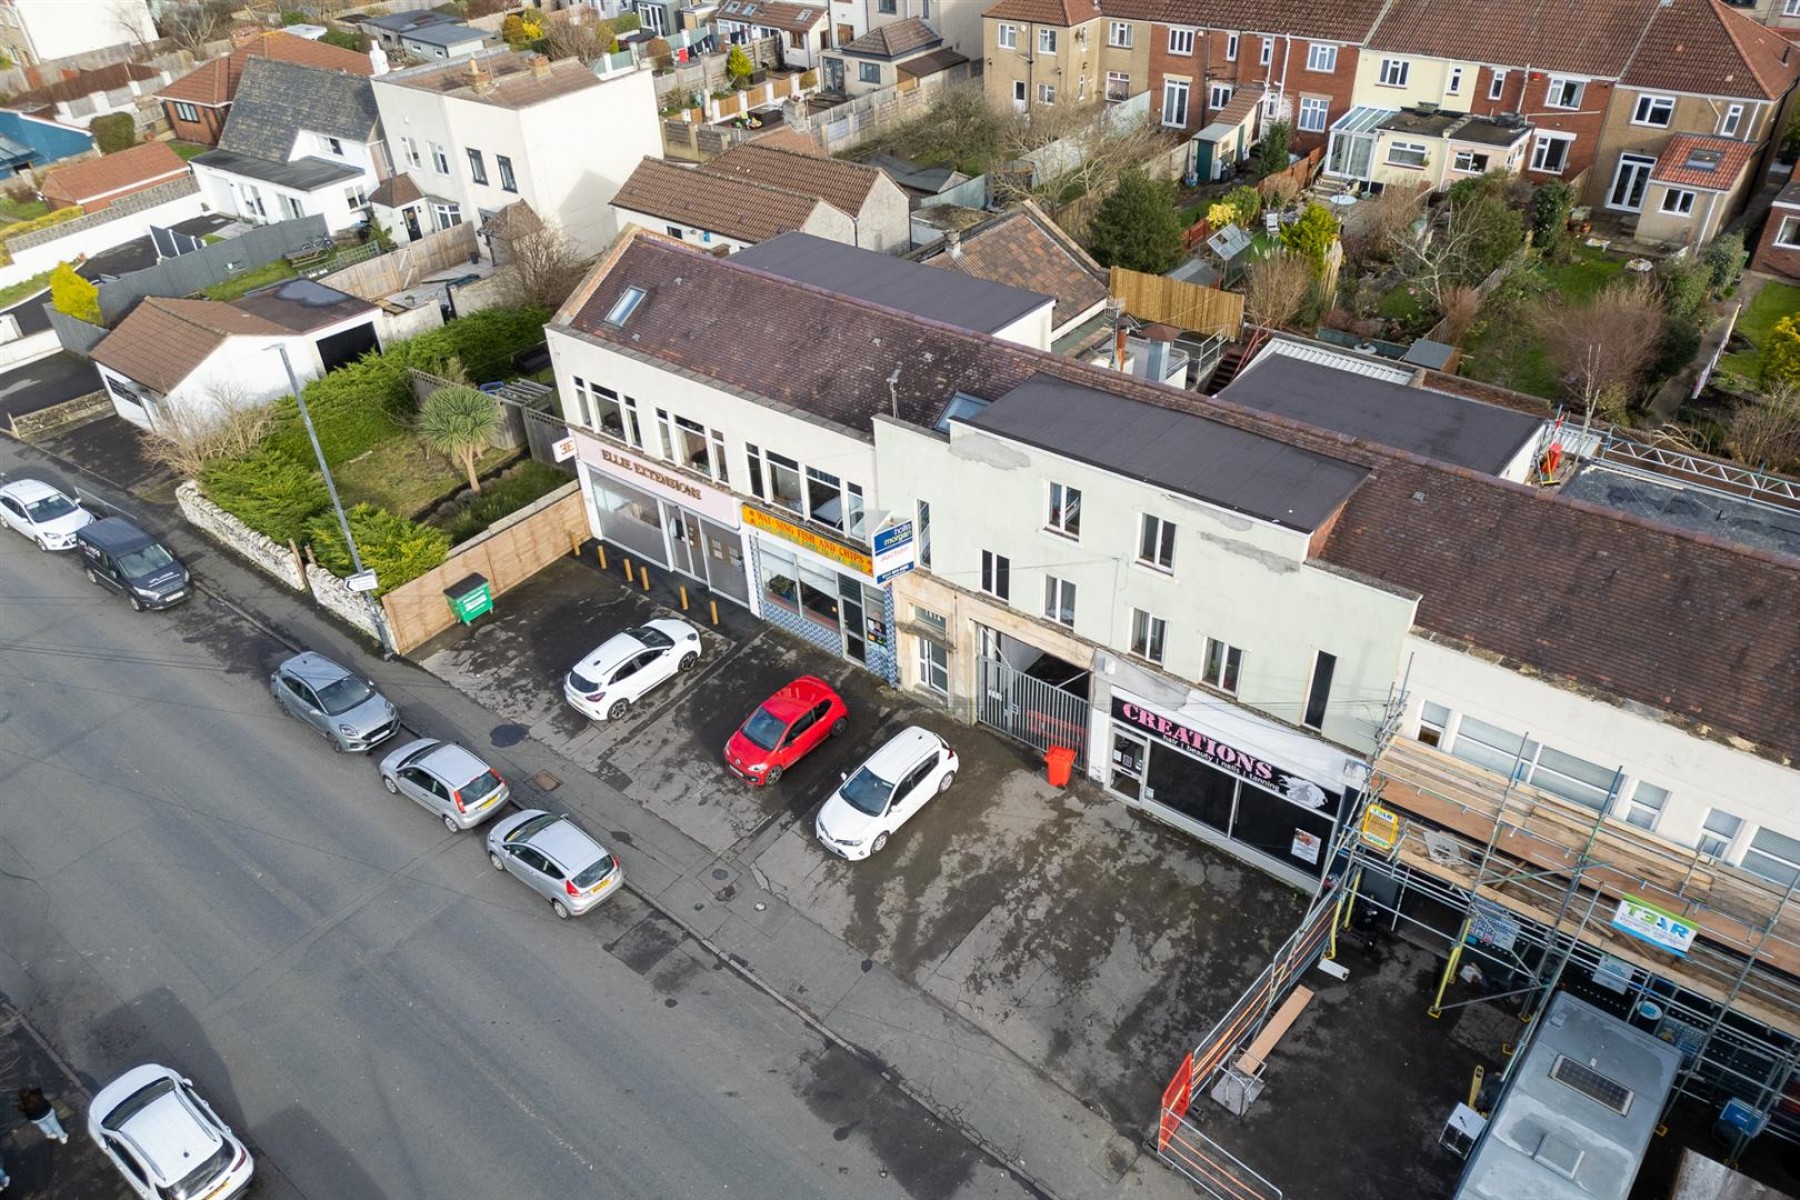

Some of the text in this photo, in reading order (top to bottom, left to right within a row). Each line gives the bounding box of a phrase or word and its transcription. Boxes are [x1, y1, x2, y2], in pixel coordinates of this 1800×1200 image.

[601, 449, 702, 500] ELLIE EXTENSIONS
[797, 530, 816, 543] FISH
[819, 540, 837, 552] AND
[839, 547, 864, 564] CHIPS
[1122, 703, 1273, 780] CREATIONS
[1162, 734, 1280, 793] hair beauty nails tanning
